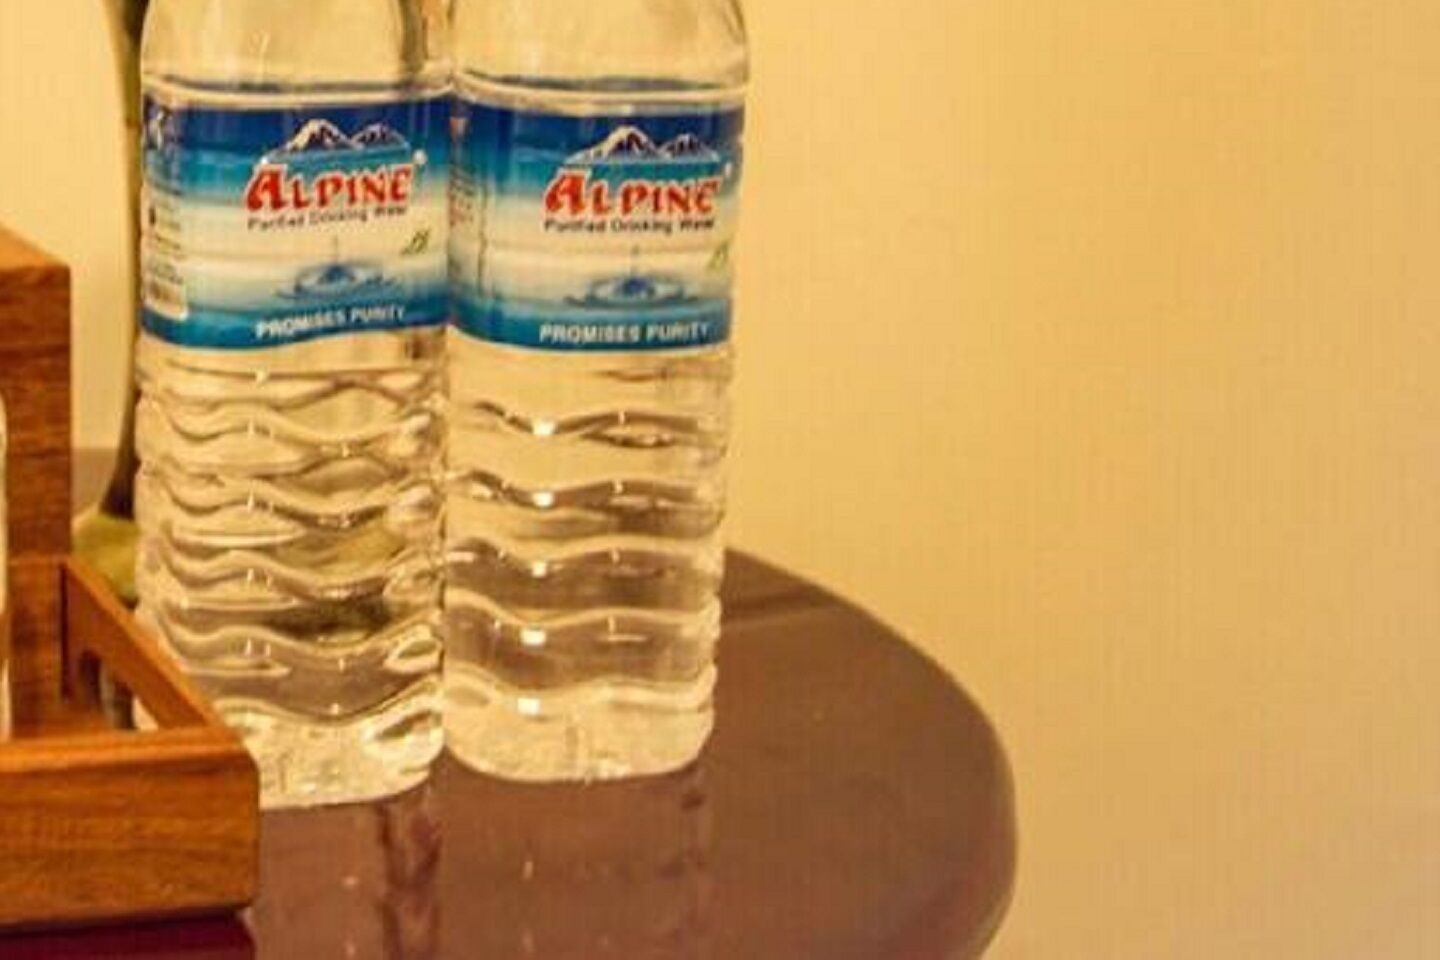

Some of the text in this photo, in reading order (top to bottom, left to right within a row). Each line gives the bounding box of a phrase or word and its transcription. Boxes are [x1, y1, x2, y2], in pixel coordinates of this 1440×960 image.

[245, 164, 414, 211] ALPINE
[543, 171, 721, 216] ALPINE
[256, 305, 405, 338] PROMISES PURITY
[539, 321, 709, 343] PROMISES PURITY
